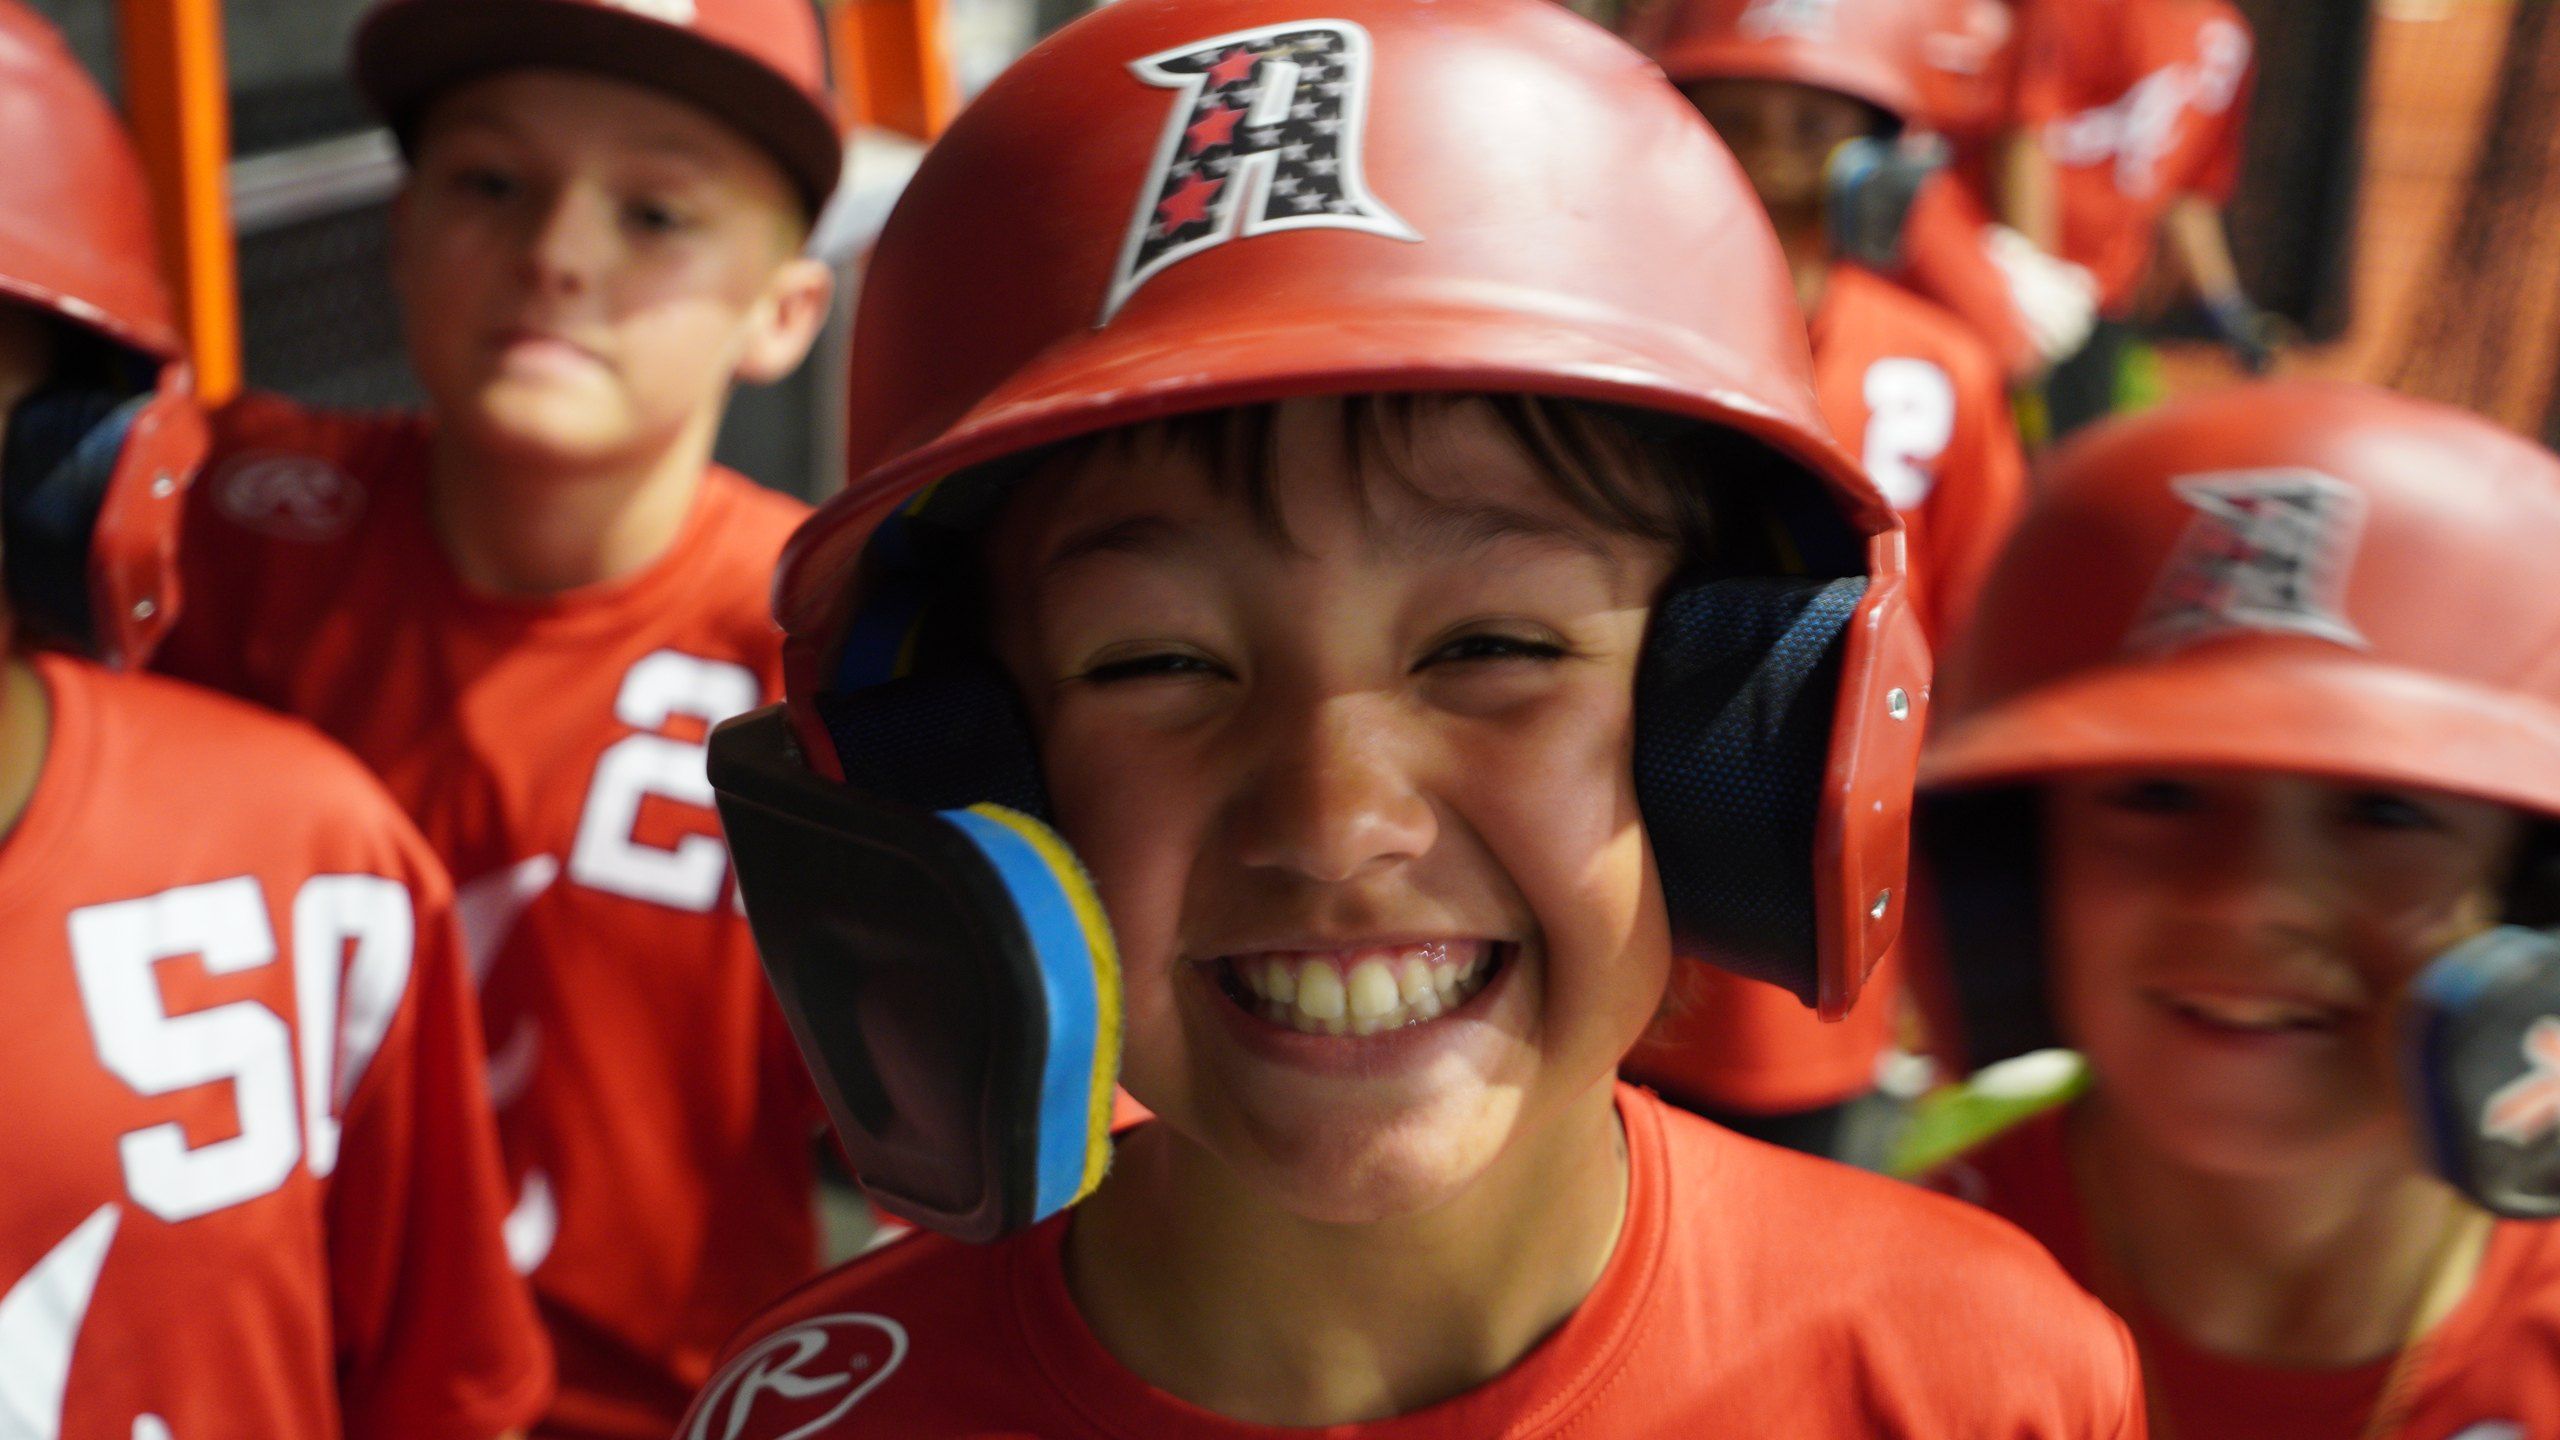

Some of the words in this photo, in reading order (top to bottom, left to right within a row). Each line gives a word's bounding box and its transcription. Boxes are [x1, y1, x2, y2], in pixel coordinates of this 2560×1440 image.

[1095, 18, 1425, 328] A
[568, 648, 762, 915] 2
[67, 874, 415, 1223] 50
